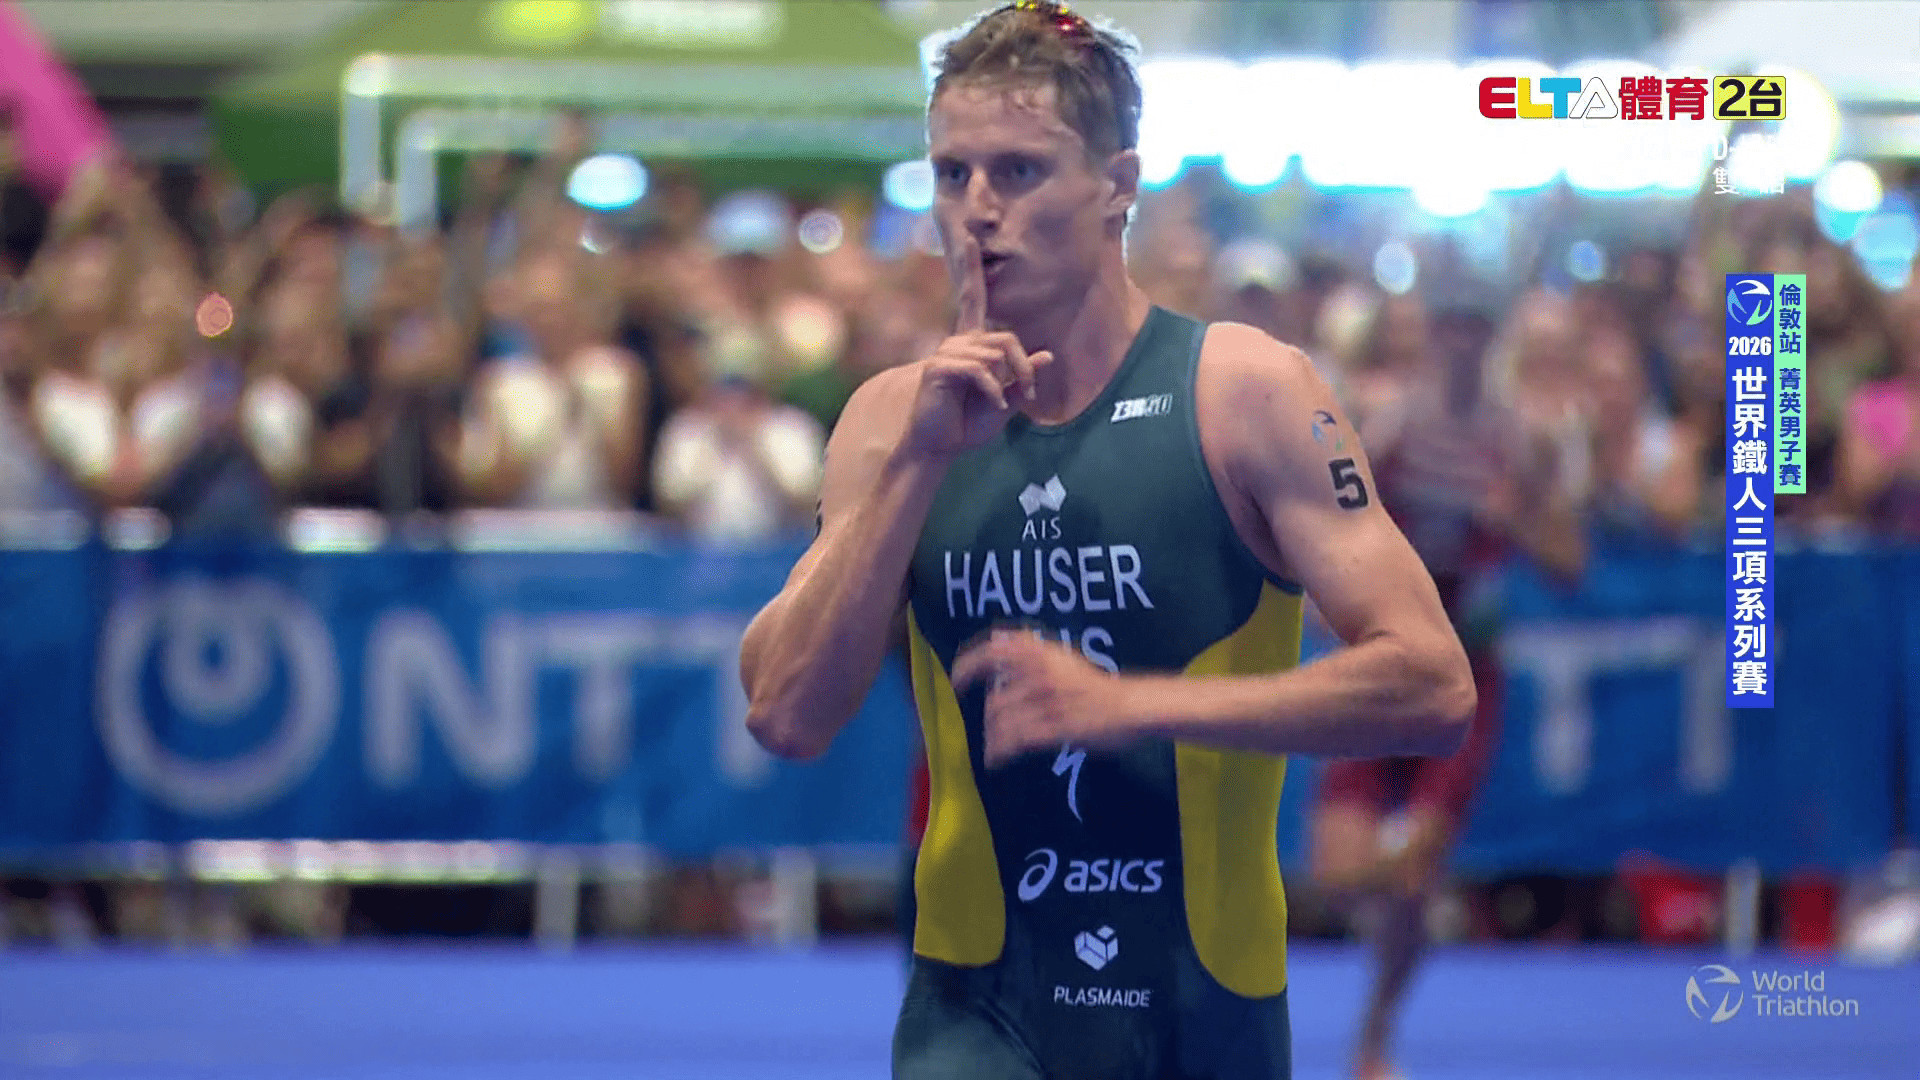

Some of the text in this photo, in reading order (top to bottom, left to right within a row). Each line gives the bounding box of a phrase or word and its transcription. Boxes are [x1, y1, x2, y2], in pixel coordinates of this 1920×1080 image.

[1328, 457, 1369, 510] 5
[1021, 517, 1062, 541] AIS
[944, 544, 1154, 618] HAUSER
[362, 605, 772, 788] NTT
[1063, 858, 1165, 893] asics
[1053, 984, 1151, 1008] PLASMAIDE
